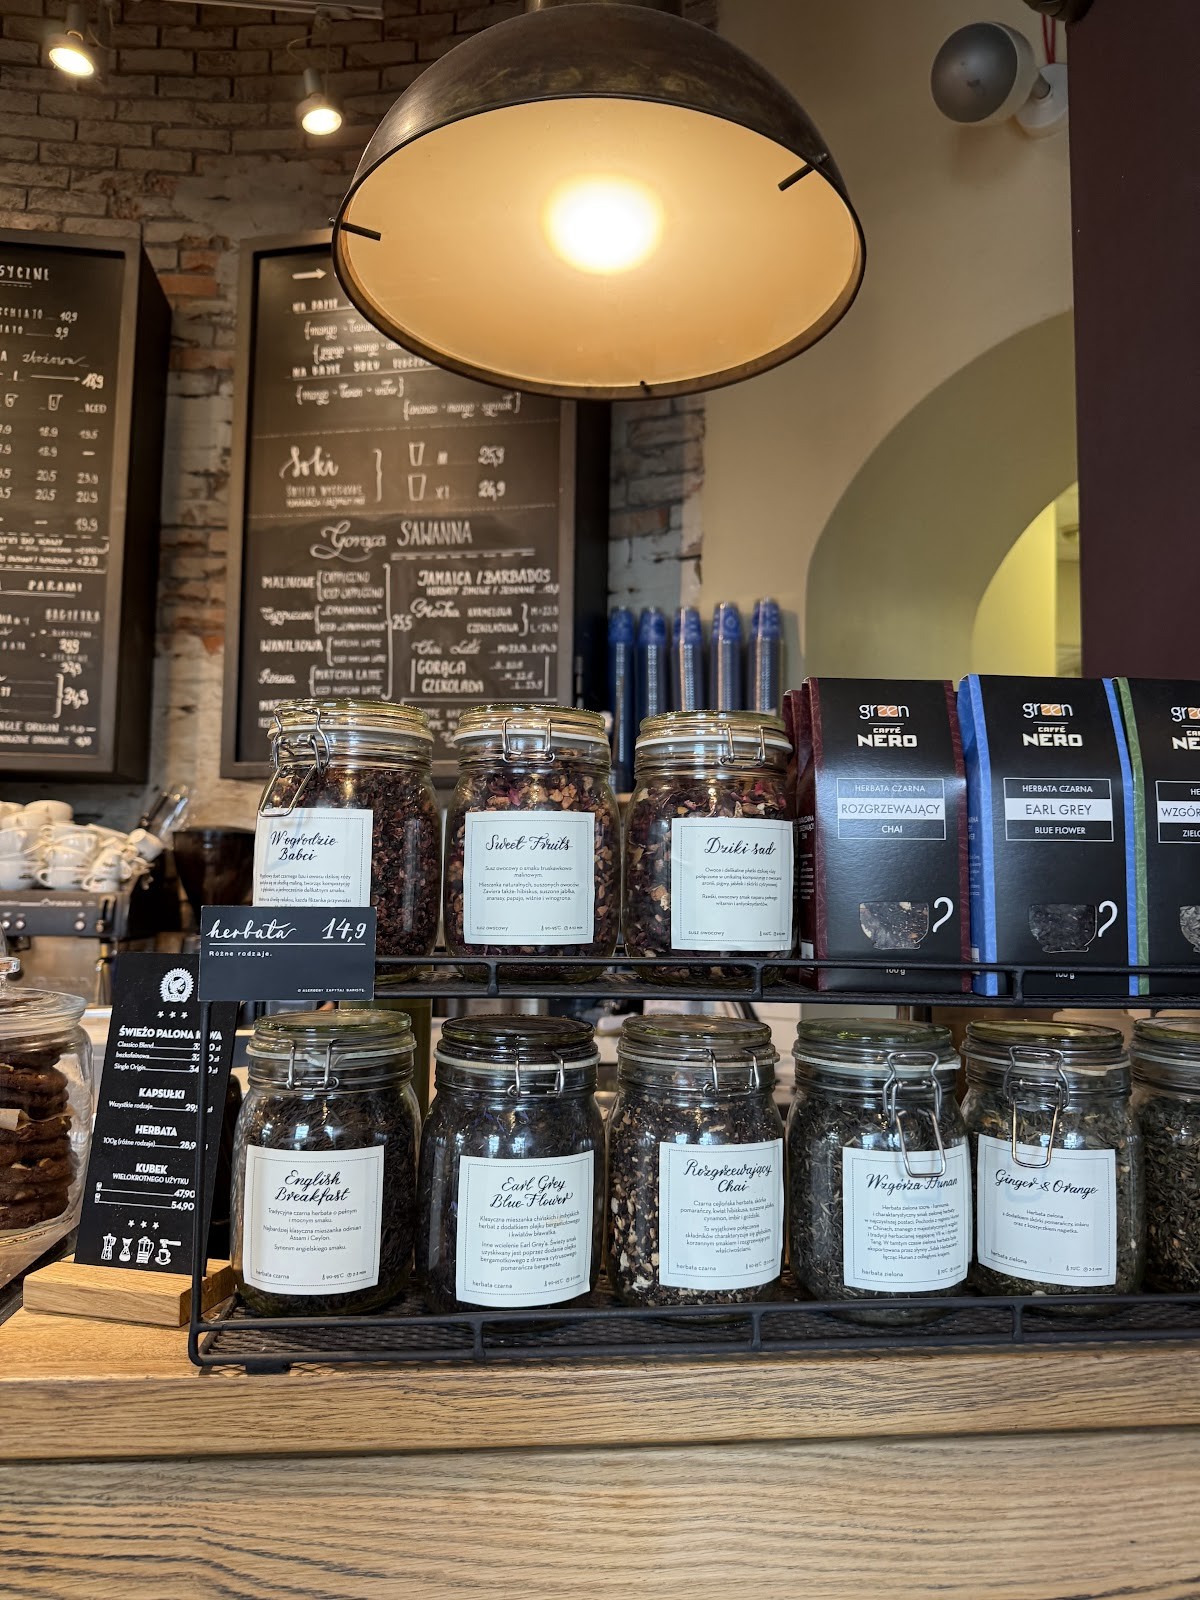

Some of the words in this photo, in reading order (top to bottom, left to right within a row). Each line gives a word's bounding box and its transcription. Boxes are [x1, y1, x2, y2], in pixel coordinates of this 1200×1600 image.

[417, 570, 471, 586] JAMAICA
[859, 704, 910, 720] green
[1022, 702, 1073, 718] green
[858, 734, 918, 747] NERO
[1022, 734, 1083, 746] NERO
[1022, 785, 1058, 793] HERBATA
[1059, 785, 1093, 793] CZARNA
[841, 804, 940, 816] ROZGRZEWAJĄCY
[1026, 804, 1055, 814] EARL
[1059, 805, 1092, 815] GREY
[1035, 826, 1054, 834] BLUE
[1055, 827, 1085, 835] FLOWER
[486, 835, 527, 850] Sweet
[529, 833, 573, 850] Fruits
[704, 837, 750, 855] Dziki
[751, 842, 776, 855] sad
[278, 848, 317, 861] Babci
[206, 919, 297, 940] herbata
[322, 918, 366, 943] 14,9
[237, 950, 273, 958] rodzaje.
[119, 1025, 155, 1038] ŚWIEŻO
[156, 1029, 193, 1039] PALONA
[195, 1031, 222, 1040] KWA
[139, 1088, 185, 1099] KAPSUŁKI
[135, 1125, 177, 1136] HERBATA
[103, 1137, 117, 1145] 100g
[135, 1163, 168, 1174] KUBEK
[684, 1159, 772, 1180] Rozgrzewający
[113, 1172, 164, 1184] WIELOKROTNEGO
[165, 1177, 189, 1185] UŻYTKU
[284, 1170, 341, 1191] English
[502, 1177, 535, 1192] Earl
[538, 1175, 566, 1193] Grey
[866, 1173, 924, 1196] Wzgórza
[995, 1169, 1038, 1191] Ginger
[1052, 1179, 1098, 1199] Orange
[717, 1179, 749, 1193] Chai
[174, 1189, 195, 1199] 47,90
[275, 1187, 350, 1206] Breakfast
[490, 1193, 524, 1209] Blue
[524, 1192, 573, 1208] Flower
[171, 1201, 194, 1211] 54,90
[677, 1262, 697, 1270] herbata
[473, 1280, 492, 1288] herbata
